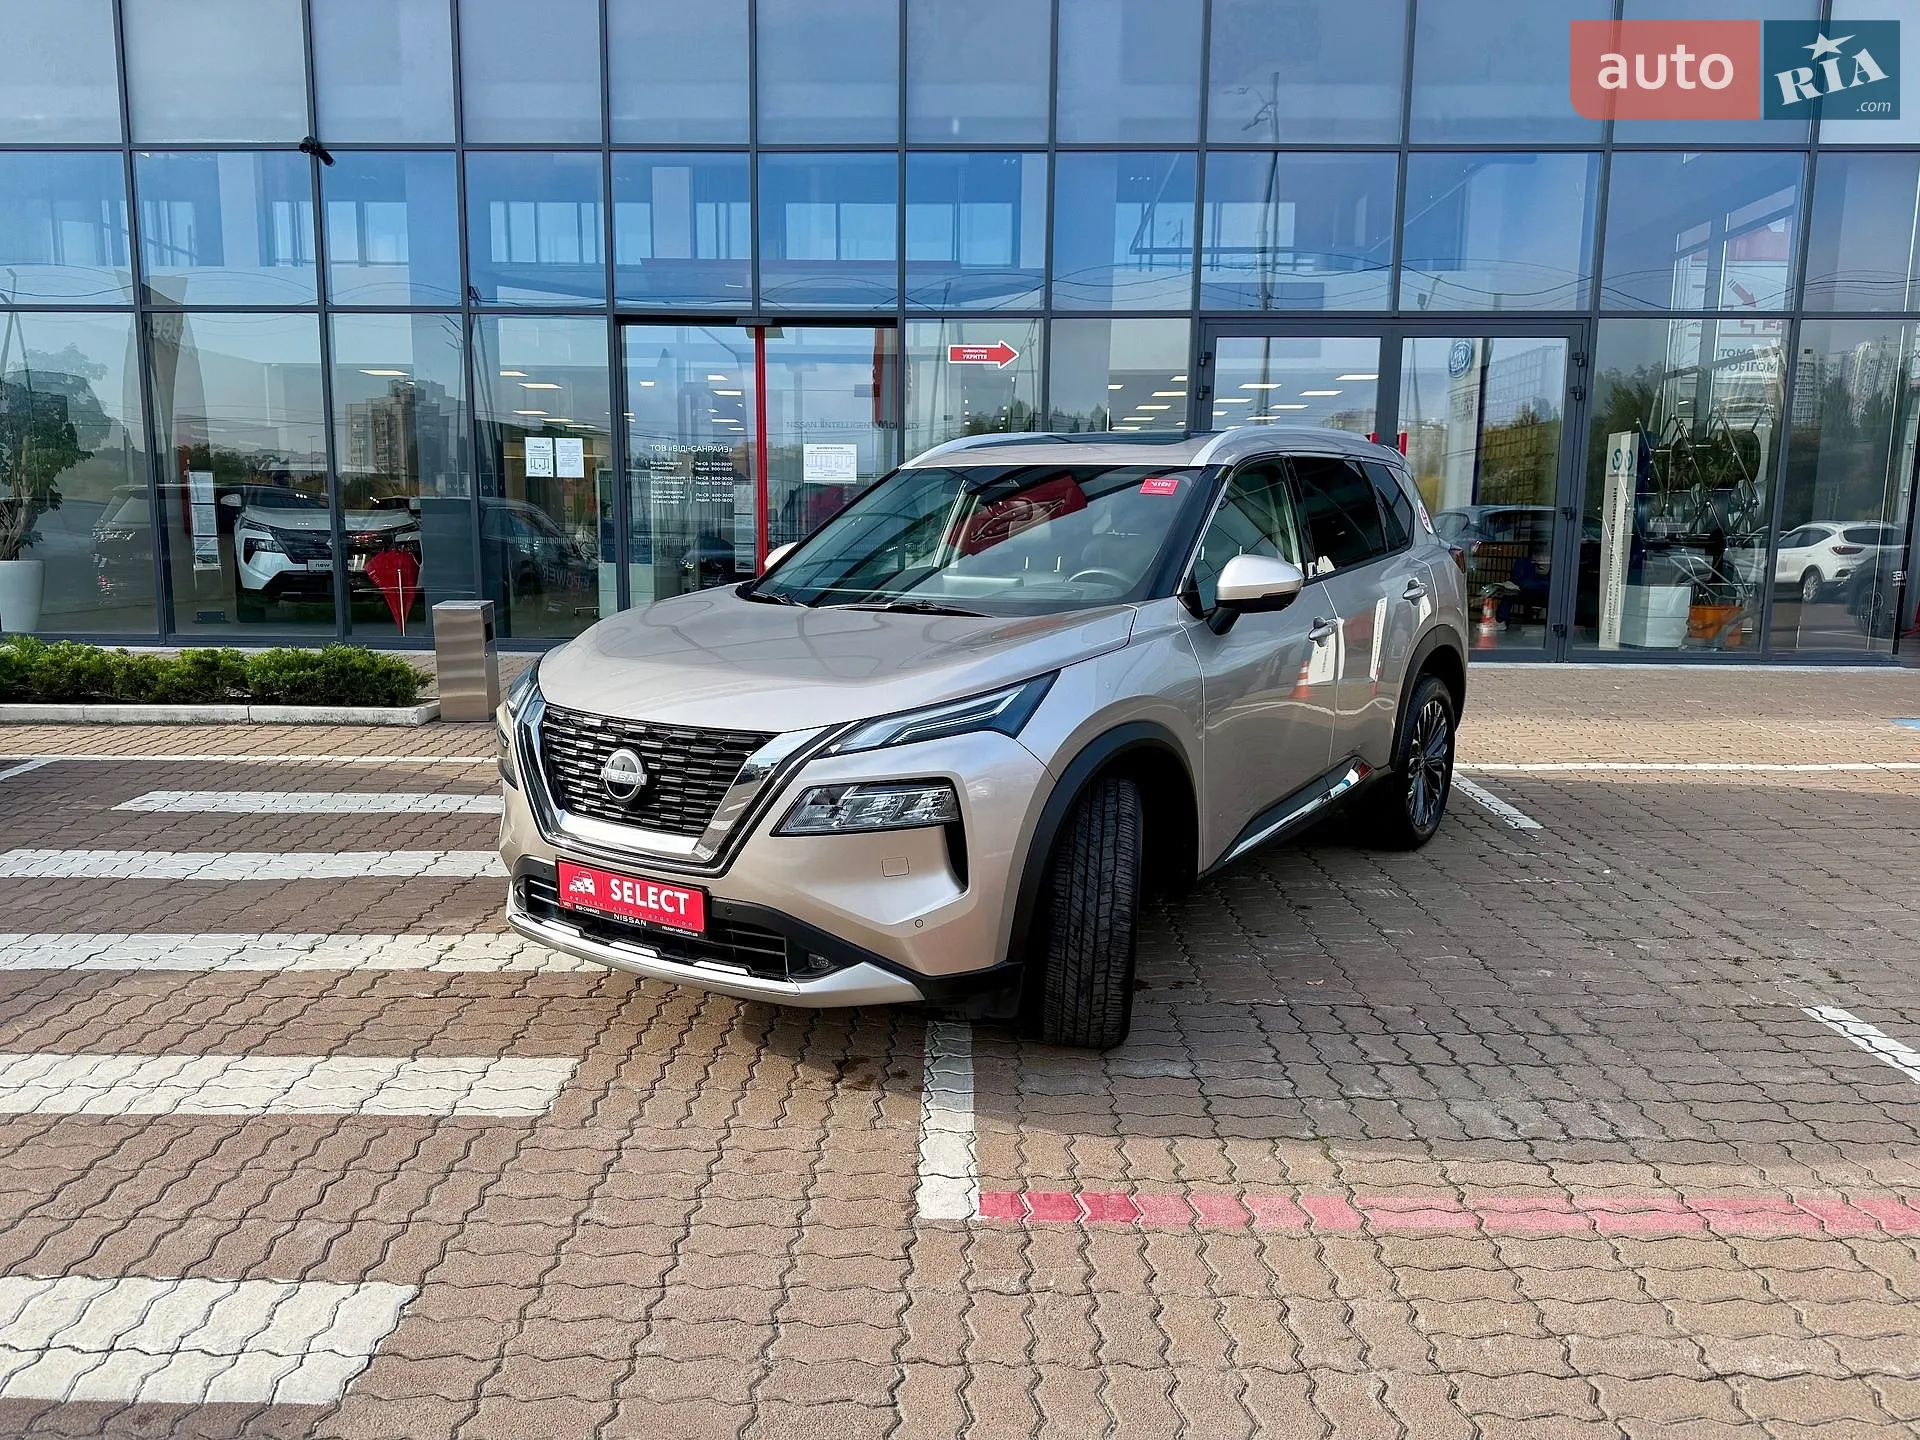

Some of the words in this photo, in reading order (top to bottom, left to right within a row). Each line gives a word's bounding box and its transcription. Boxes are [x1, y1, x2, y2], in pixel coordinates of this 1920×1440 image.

[1717, 361, 1777, 372] РОБІГОМ
[601, 768, 645, 784] NISSAN
[610, 878, 689, 915] SELECT
[613, 913, 647, 927] NISSAN
